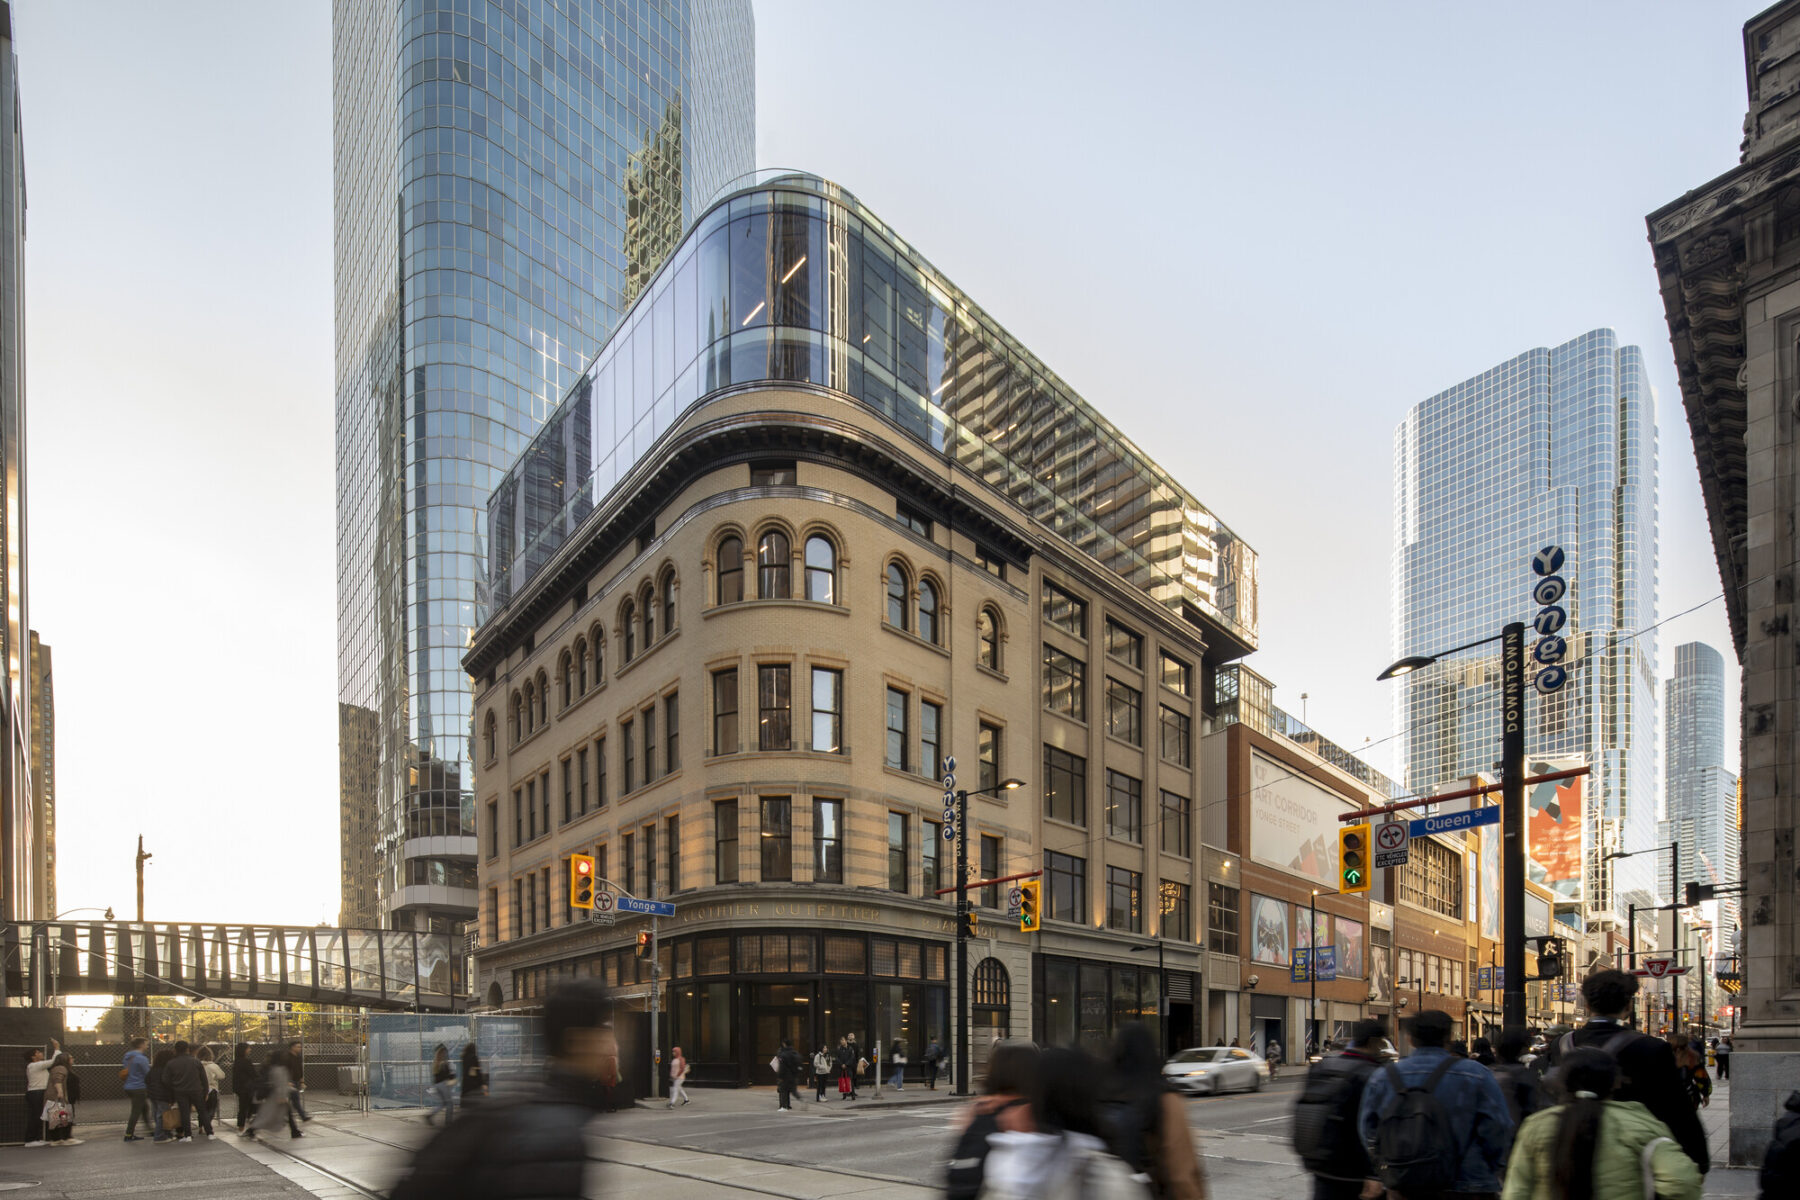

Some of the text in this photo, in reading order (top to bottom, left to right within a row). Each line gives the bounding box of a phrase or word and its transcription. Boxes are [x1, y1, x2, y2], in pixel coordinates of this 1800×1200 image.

[1506, 632, 1519, 734] DOWNTOWN
[943, 757, 956, 840] Yonge
[1255, 787, 1318, 825] ART CORRIDOR
[1255, 807, 1301, 834] YONGE STREET
[1425, 810, 1483, 832] Queen St
[1377, 857, 1407, 867] EXCEPTED
[1386, 851, 1407, 860] VEHICLES
[627, 899, 656, 913] Yonge
[683, 903, 881, 923] CLOTHIER OUTFITTER
[1294, 964, 1306, 980] LIFE
